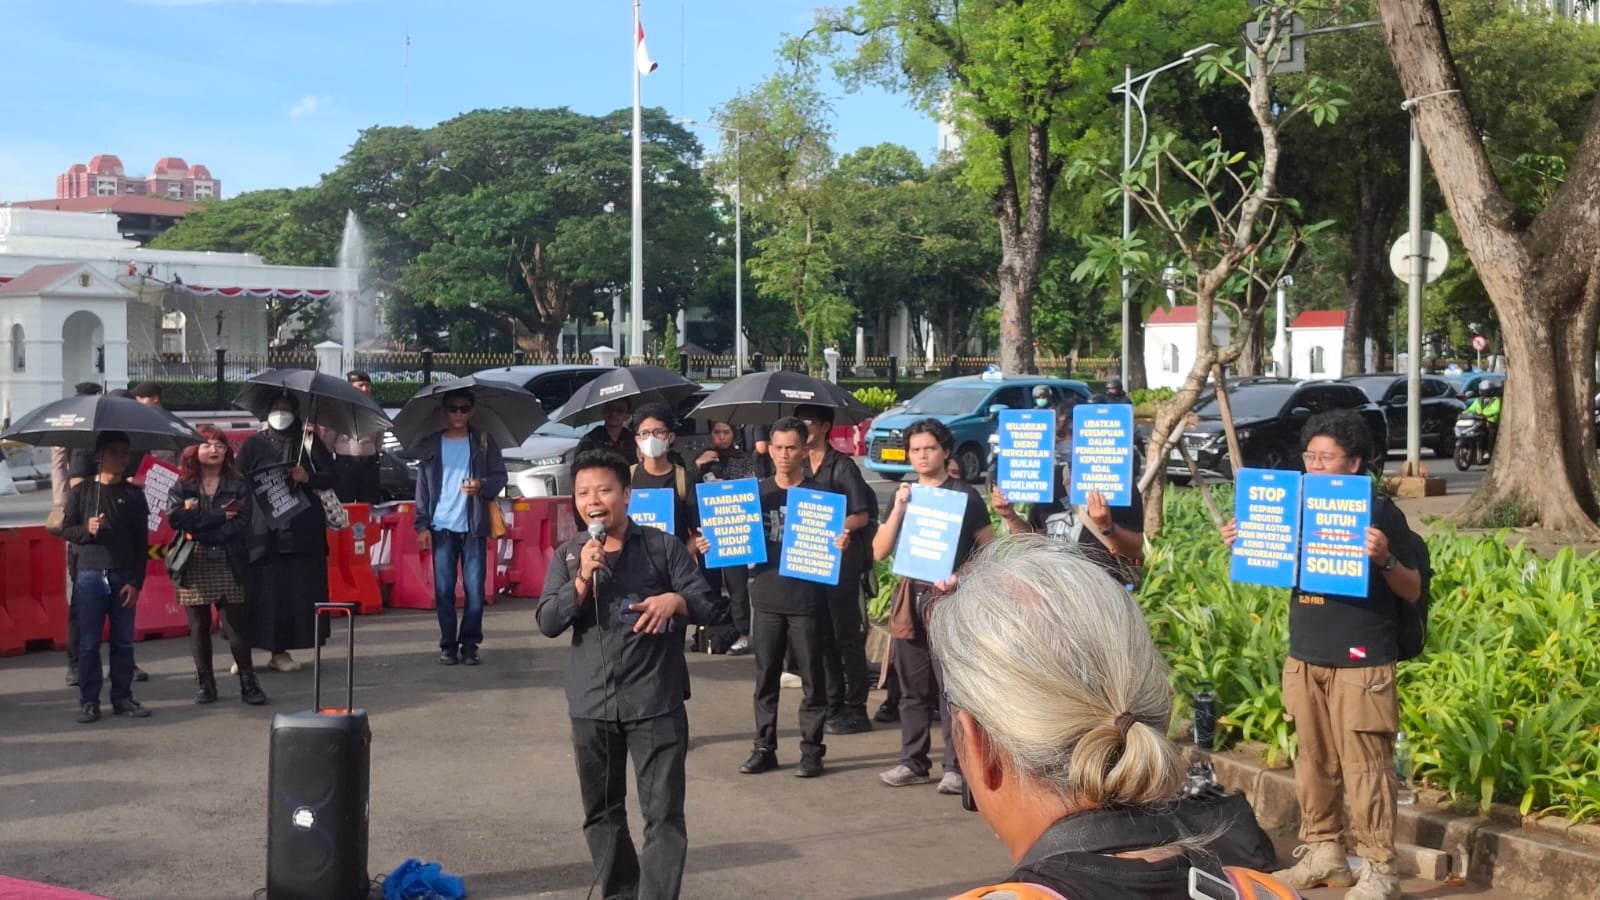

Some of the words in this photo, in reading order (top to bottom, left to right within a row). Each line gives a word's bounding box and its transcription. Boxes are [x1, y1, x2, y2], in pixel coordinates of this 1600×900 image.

[1006, 423, 1047, 431] WUJUDKAN
[1084, 420, 1120, 428] LIBATKAN
[1011, 432, 1042, 440] TRANSISI
[1080, 429, 1124, 437] PEREMPUAN
[1013, 440, 1038, 448] ENERGI
[1088, 438, 1115, 446] DALAM
[1002, 449, 1050, 457] BERKEADILAN
[1076, 447, 1128, 455] PENGAMBILAN
[1010, 459, 1040, 468] BUKAN
[1079, 456, 1124, 464] KEPUTUSAN
[1091, 465, 1110, 473] SOAL
[1010, 470, 1040, 479] UNTUK
[1081, 473, 1120, 482] TAMBANG
[1001, 480, 1048, 490] SEGELINTIR
[1077, 482, 1093, 490] DAN
[1094, 483, 1123, 491] PROYEK
[1008, 491, 1040, 501] ORANG
[1249, 486, 1286, 502] STOP
[703, 493, 755, 506] TAMBANG
[714, 504, 745, 515] NIKEL,
[798, 502, 816, 511] AKUI
[816, 504, 833, 513] DAN
[1249, 504, 1283, 514] EKSPANSI
[632, 512, 656, 522] PLTU
[703, 513, 760, 526] MERAMPAS
[798, 509, 832, 521] LINDUNGI
[1250, 513, 1282, 523] INDUSTRI
[1316, 512, 1356, 527] BUTUH
[802, 518, 826, 528] PERAN
[1240, 521, 1265, 531] ENERGI
[1266, 524, 1291, 533] KOTOR
[714, 524, 751, 536] RUANG
[792, 524, 835, 537] PEREMPUAN
[1321, 527, 1350, 541] PLTU
[718, 535, 749, 546] HIDUP
[797, 533, 828, 544] SEBAGAI
[1238, 530, 1254, 538] DEMI
[1255, 532, 1292, 542] INVESTASI
[794, 541, 828, 552] PENJAGA
[1242, 540, 1264, 549] ASING
[1266, 542, 1286, 551] YANG
[1308, 542, 1362, 558] INDUSTRI
[719, 546, 745, 556] KAMI
[787, 547, 835, 561] LINGKUNGAN
[1233, 547, 1295, 560] MENGORBANKAN
[787, 555, 802, 563] DAN
[804, 557, 834, 569] SUMBER
[1247, 558, 1278, 568] RAKYAT!
[1307, 557, 1362, 576] SOLUSI
